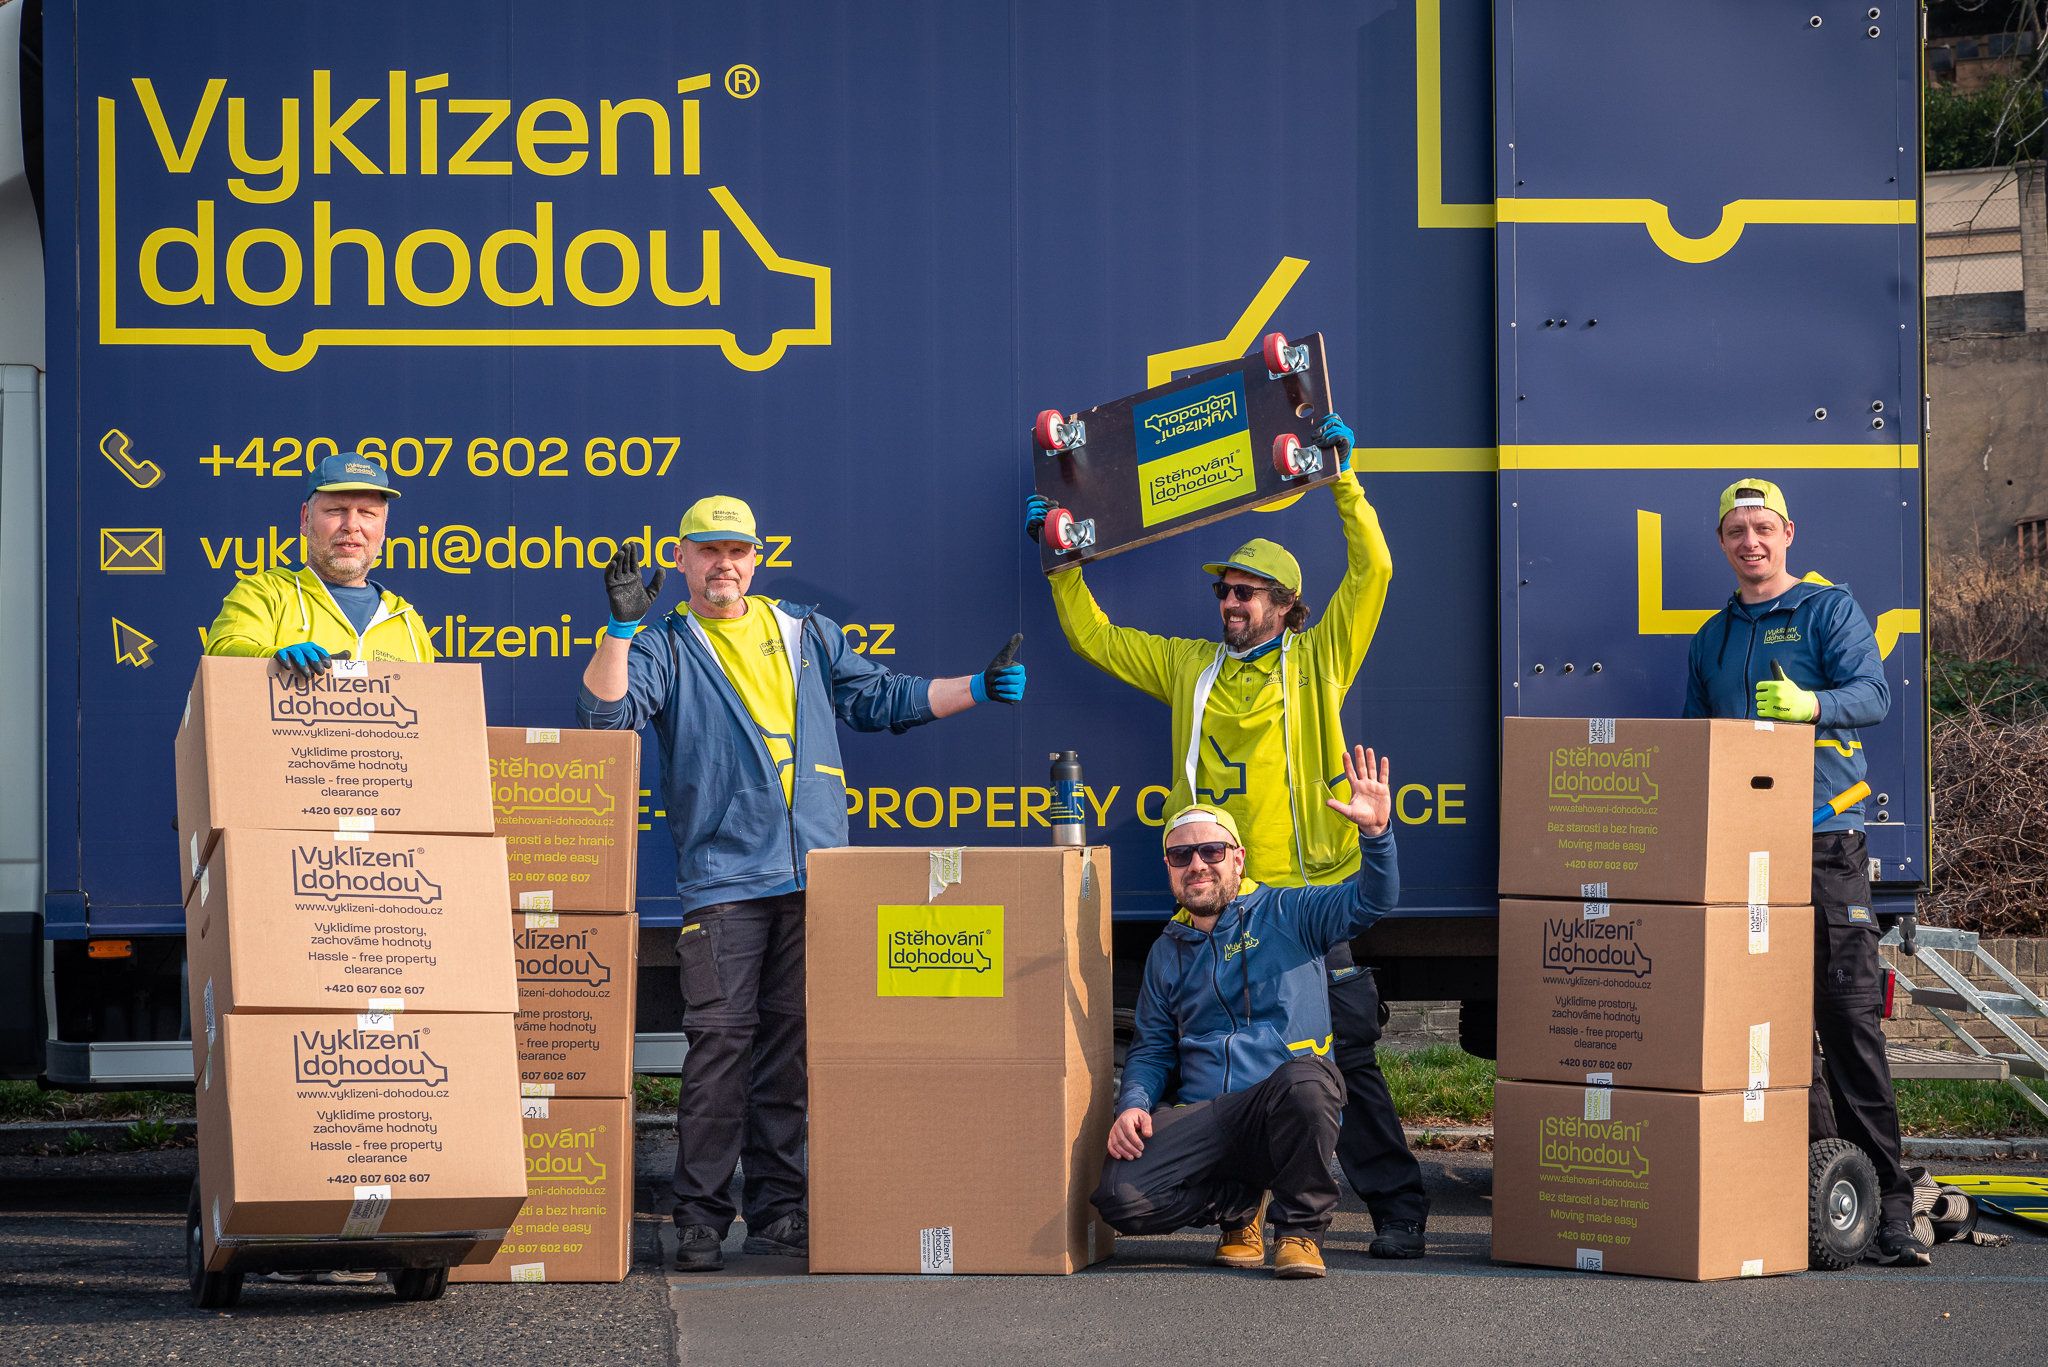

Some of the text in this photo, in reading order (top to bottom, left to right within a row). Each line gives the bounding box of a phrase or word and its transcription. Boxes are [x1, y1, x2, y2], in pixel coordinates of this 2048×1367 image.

[131, 69, 711, 204] Vyklízení
[138, 200, 720, 306] dohodou
[1158, 395, 1231, 428] dohodou
[1161, 408, 1234, 443] Vyklízení
[199, 437, 681, 477] +420 607 602 607
[1153, 451, 1236, 488] Stěhování
[1156, 471, 1228, 500] dohodou
[200, 524, 792, 579] vyklni@dohodoz
[278, 696, 395, 717] dohodou
[272, 727, 419, 739] www.vyklizeni-dohodou.cz
[351, 748, 403, 760] prostory,
[1555, 746, 1652, 768] Stěhování
[288, 759, 408, 772] zachováme hodnoty
[489, 757, 606, 780] Stěhování
[285, 774, 326, 785] Hassle
[336, 775, 360, 786] free
[362, 776, 413, 788] property
[1554, 771, 1640, 792] dohodou
[321, 788, 379, 797] clearance
[301, 807, 401, 817] +420 607 602 607
[846, 785, 1120, 829] PROPERY
[1548, 804, 1658, 815] www.stehovani-dohodou.cz
[494, 815, 614, 826] w.stehovani-dohodou.cz
[1547, 822, 1658, 835] Bez starostí a bez hranic
[504, 835, 541, 846] tarostí
[554, 836, 575, 845] bez
[578, 836, 615, 846] hranic
[1558, 839, 1646, 853] Moving made easy
[298, 846, 415, 870] Vyklízení
[507, 851, 599, 866] ving made easy
[1564, 860, 1639, 870] +420 607 602 607
[301, 869, 419, 892] dohodou
[509, 872, 590, 883] 20 607 602 607
[295, 902, 443, 915] www.vyklizeni-dohodou.cz
[374, 924, 427, 936] prostory,
[1549, 918, 1635, 943] Vyklízení
[311, 935, 432, 949] zachováme hodnoty
[513, 929, 588, 950] klízení
[894, 930, 984, 946] Stěhování
[308, 951, 349, 962] Hassle
[359, 952, 383, 963] free
[386, 954, 437, 966] property
[894, 949, 974, 964] dohodou
[1549, 942, 1636, 965] dohodou
[344, 965, 402, 975] clearance
[515, 954, 590, 975] odou
[324, 984, 425, 995] +420 607 602 607
[1543, 976, 1652, 989] www.vyklizeni-dohodou.cz
[518, 988, 610, 998] lizeni-dohodou.cz
[1598, 999, 1637, 1011] prostory,
[543, 1010, 592, 1021] prostory,
[1552, 1009, 1641, 1024] zachováme hodnoty
[550, 1022, 596, 1033] hodnoty
[1549, 1025, 1578, 1035] Hassle
[1586, 1026, 1603, 1036] free
[1605, 1028, 1643, 1041] property
[300, 1029, 421, 1055] Vyklízení
[527, 1038, 600, 1050] free property
[1574, 1039, 1617, 1050] clearance
[518, 1051, 567, 1061] learance
[303, 1054, 425, 1076] dohodou
[1559, 1058, 1632, 1070] +420 607 602 607
[521, 1072, 586, 1080] 607 602 607
[297, 1088, 449, 1100] www.vyklizeni-dohodou.cz
[317, 1110, 432, 1122] Vyklidíme prostory,
[313, 1122, 437, 1135] zachováme hodnoty
[1545, 1115, 1641, 1142] Stěhování
[523, 1128, 596, 1149] ování
[310, 1141, 352, 1151] Hassle
[362, 1140, 388, 1150] free
[390, 1140, 443, 1152] property
[1545, 1139, 1630, 1166] dohodou
[347, 1153, 407, 1163] clearance
[526, 1152, 582, 1173] odou
[327, 1174, 430, 1184] +420 607 602 607
[1540, 1174, 1649, 1189] www.stehovani-dohodou.cz
[527, 1186, 606, 1196] ani-dohodou.cz
[1539, 1191, 1649, 1210] Bez starostí a bez hranic
[536, 1207, 543, 1215] a
[546, 1206, 567, 1216] bez
[570, 1205, 607, 1215] hranic
[1550, 1209, 1638, 1228] Moving made easy
[526, 1222, 559, 1233] made
[562, 1223, 592, 1235] easy
[1557, 1231, 1631, 1245] +420 607 602 607
[497, 1244, 583, 1254] 20 607 602 607
